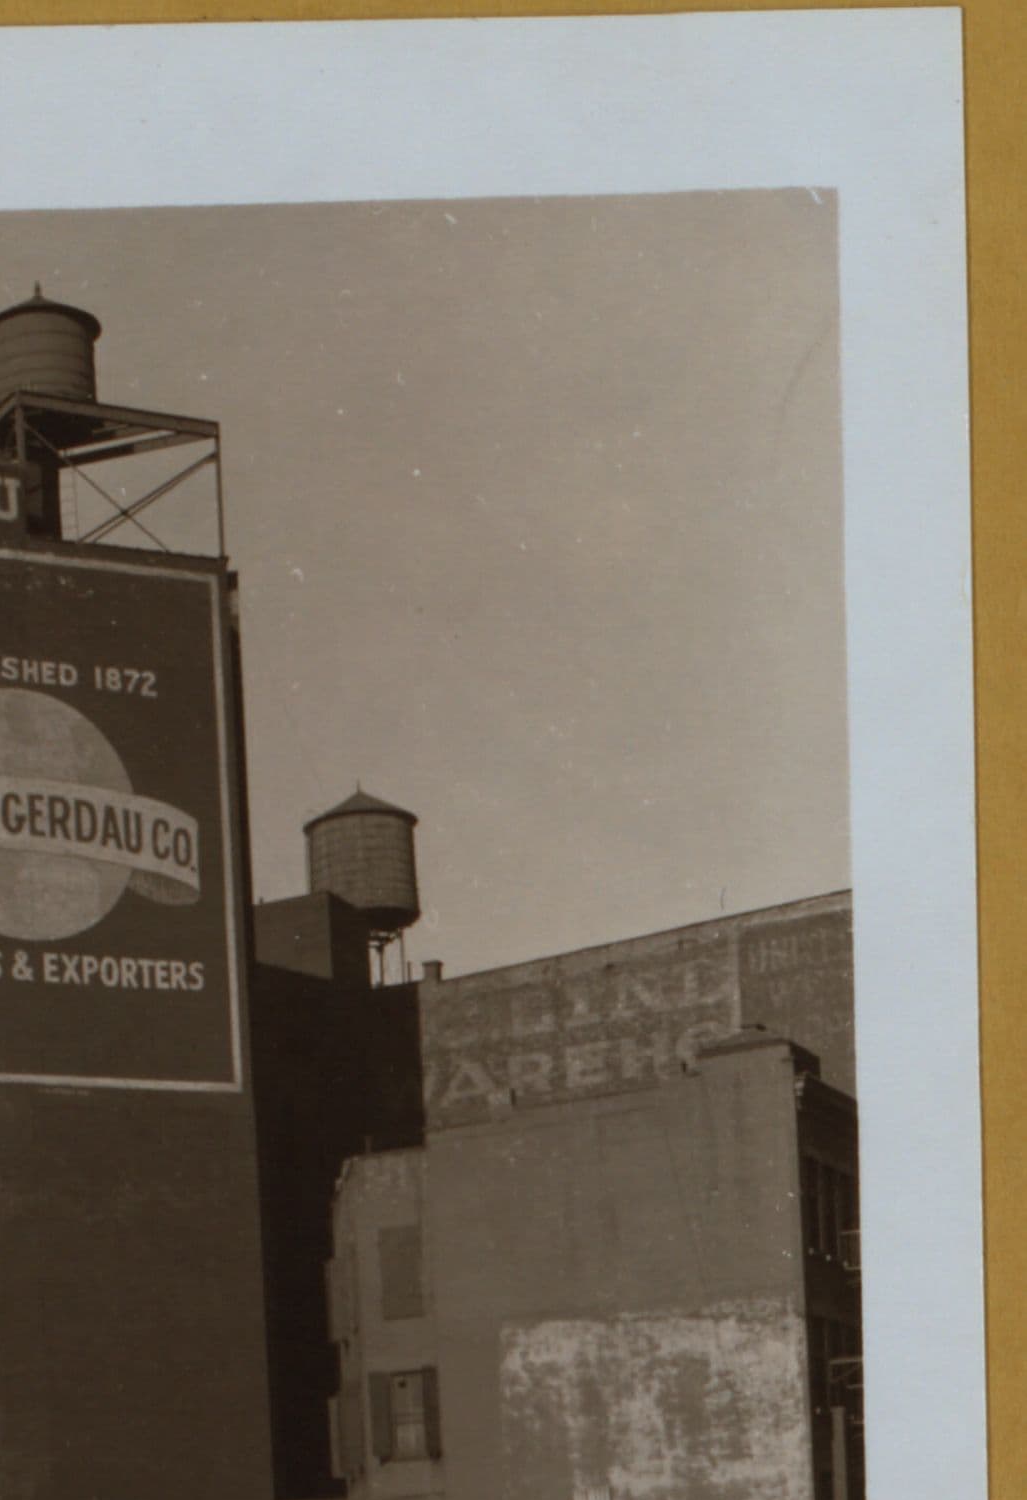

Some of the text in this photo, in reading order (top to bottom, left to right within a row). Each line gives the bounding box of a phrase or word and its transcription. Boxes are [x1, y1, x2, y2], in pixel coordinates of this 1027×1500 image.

[94, 665, 158, 697] 1872
[1, 792, 143, 855] GERDAU
[152, 818, 197, 873] CO.
[12, 949, 34, 982] &
[43, 953, 205, 991] EXPORTERS
